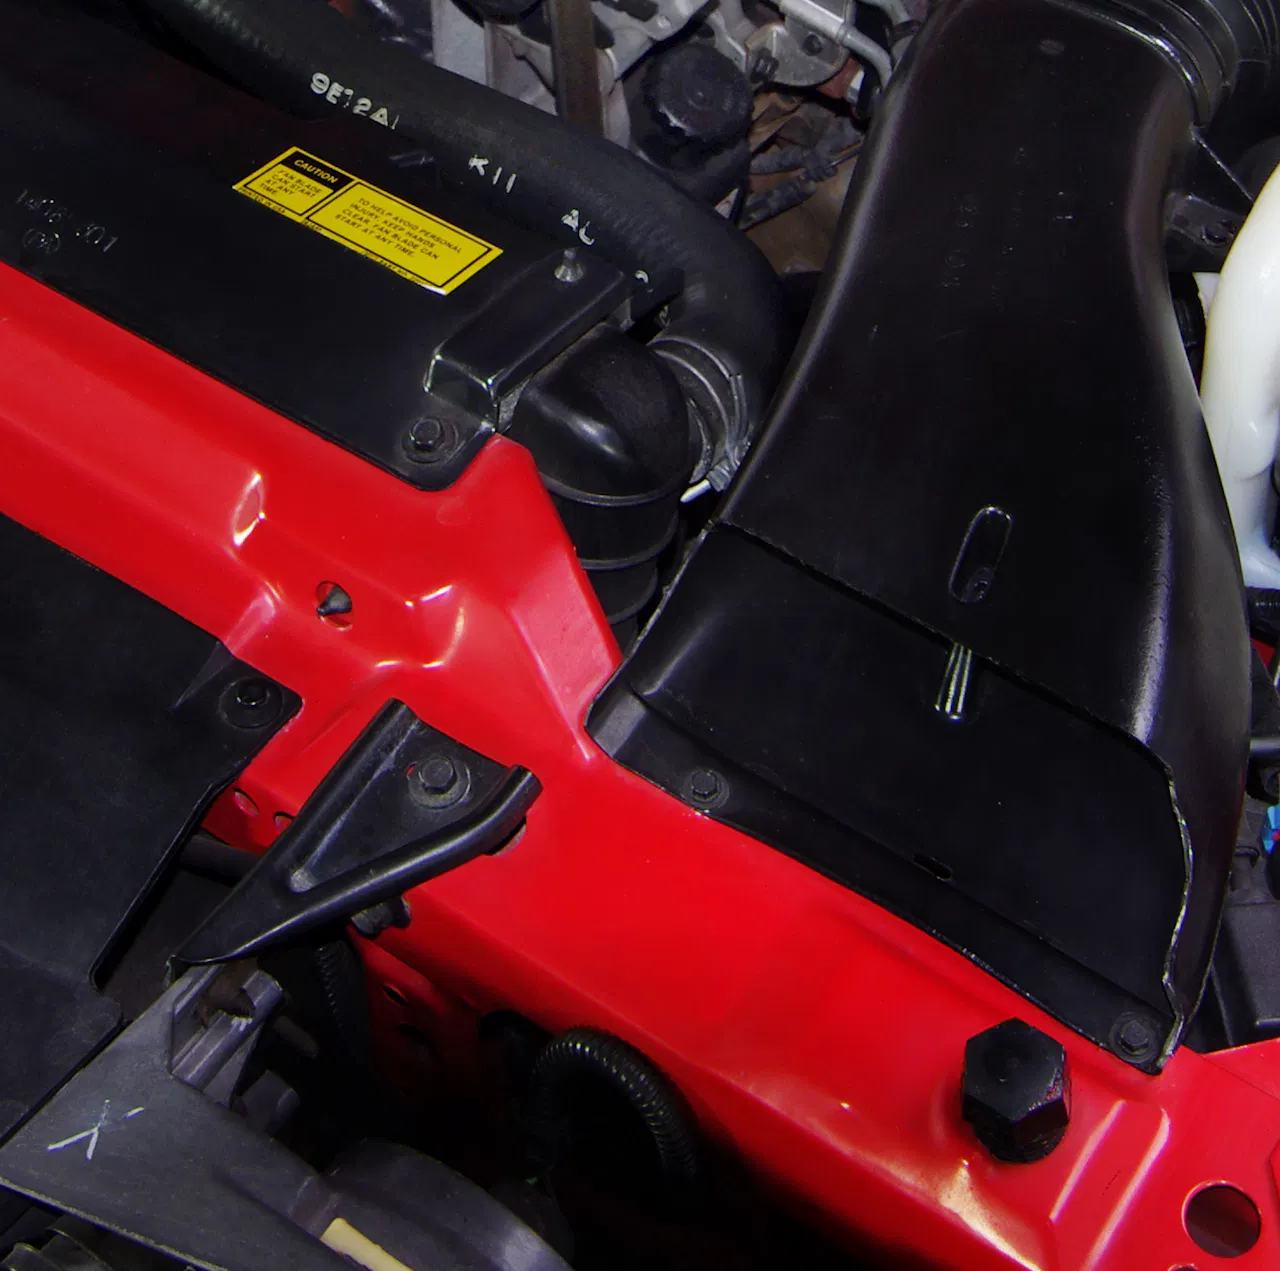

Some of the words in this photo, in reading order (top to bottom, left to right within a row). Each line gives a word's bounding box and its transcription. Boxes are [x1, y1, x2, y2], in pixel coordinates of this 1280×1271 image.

[278, 170, 296, 180] FAN
[296, 180, 322, 194] BLADE
[294, 159, 339, 183] CAUTION
[272, 175, 290, 185] CAN
[292, 185, 316, 198] START
[278, 186, 294, 195] ANY
[335, 215, 360, 229] START
[375, 235, 393, 245] ANY
[358, 198, 371, 206] TO
[370, 205, 393, 218] HELP
[393, 216, 419, 230] AVOID
[419, 229, 464, 253] PERSONAL
[383, 220, 404, 232] KEEP
[406, 232, 436, 248] HANDS
[373, 224, 391, 235] FAN
[392, 234, 419, 249] BLADE
[420, 248, 440, 259] CAN
